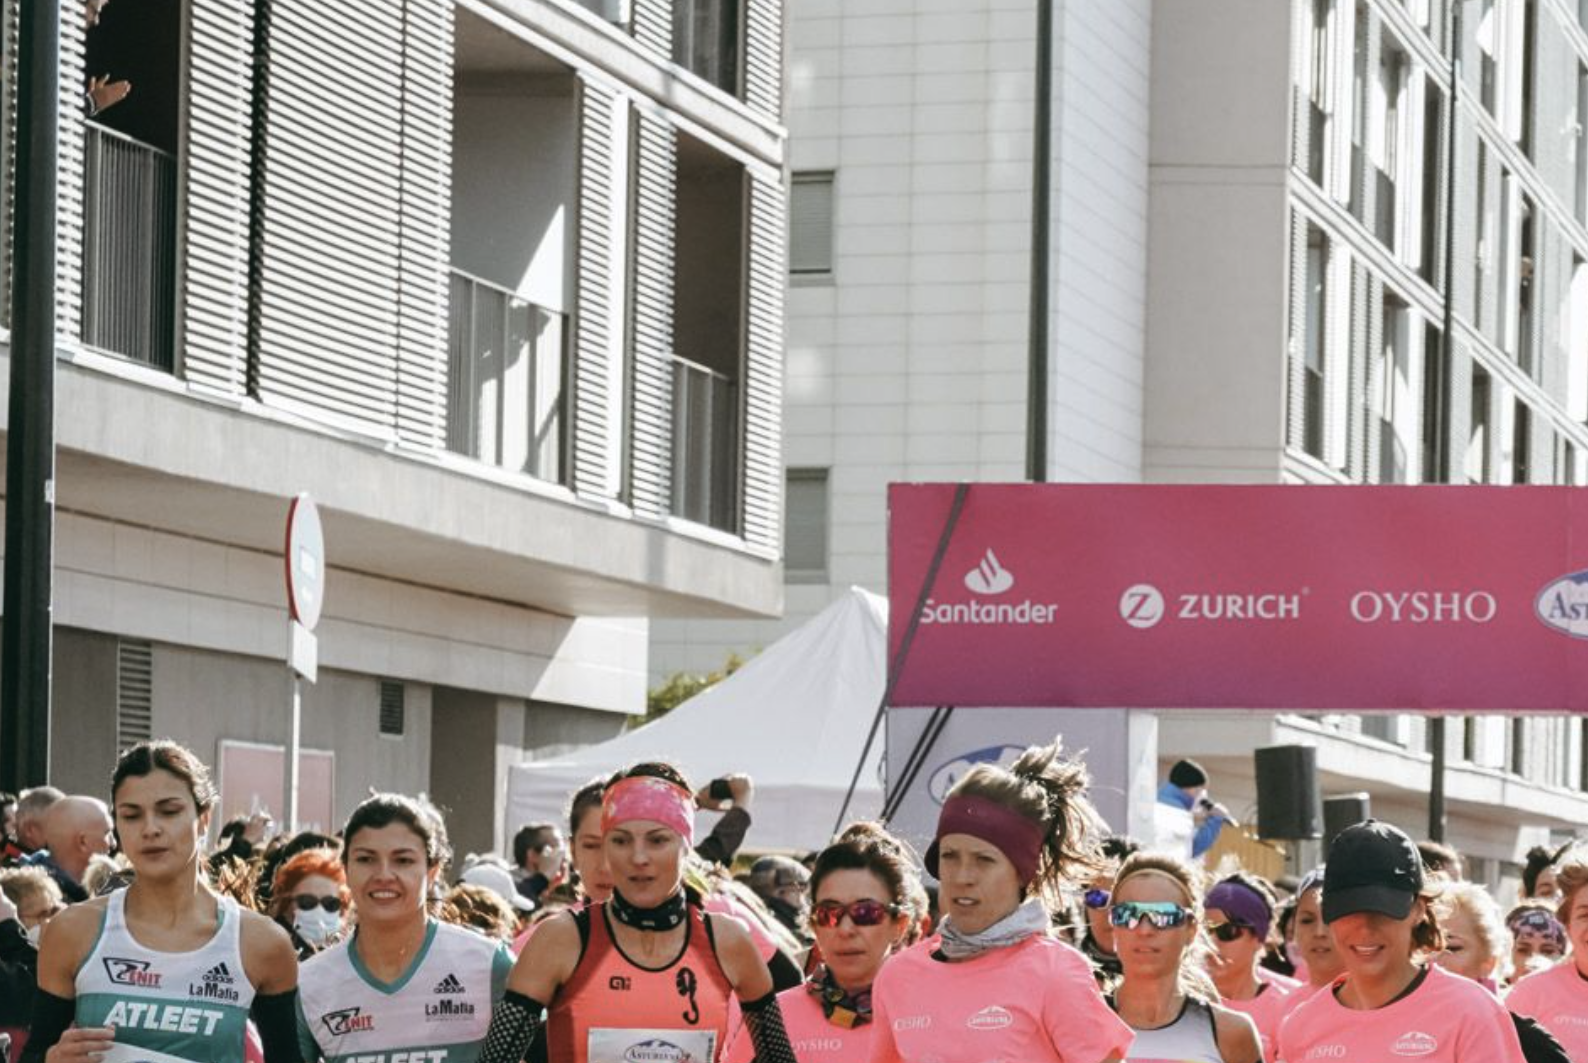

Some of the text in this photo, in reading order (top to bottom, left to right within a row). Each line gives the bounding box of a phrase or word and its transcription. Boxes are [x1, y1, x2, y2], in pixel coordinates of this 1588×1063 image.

[919, 600, 1058, 624] Santander
[1178, 594, 1299, 619] ZURICH
[1350, 591, 1497, 623] OYSHO
[202, 974, 234, 984] adidas
[103, 1001, 223, 1036] ATLEET
